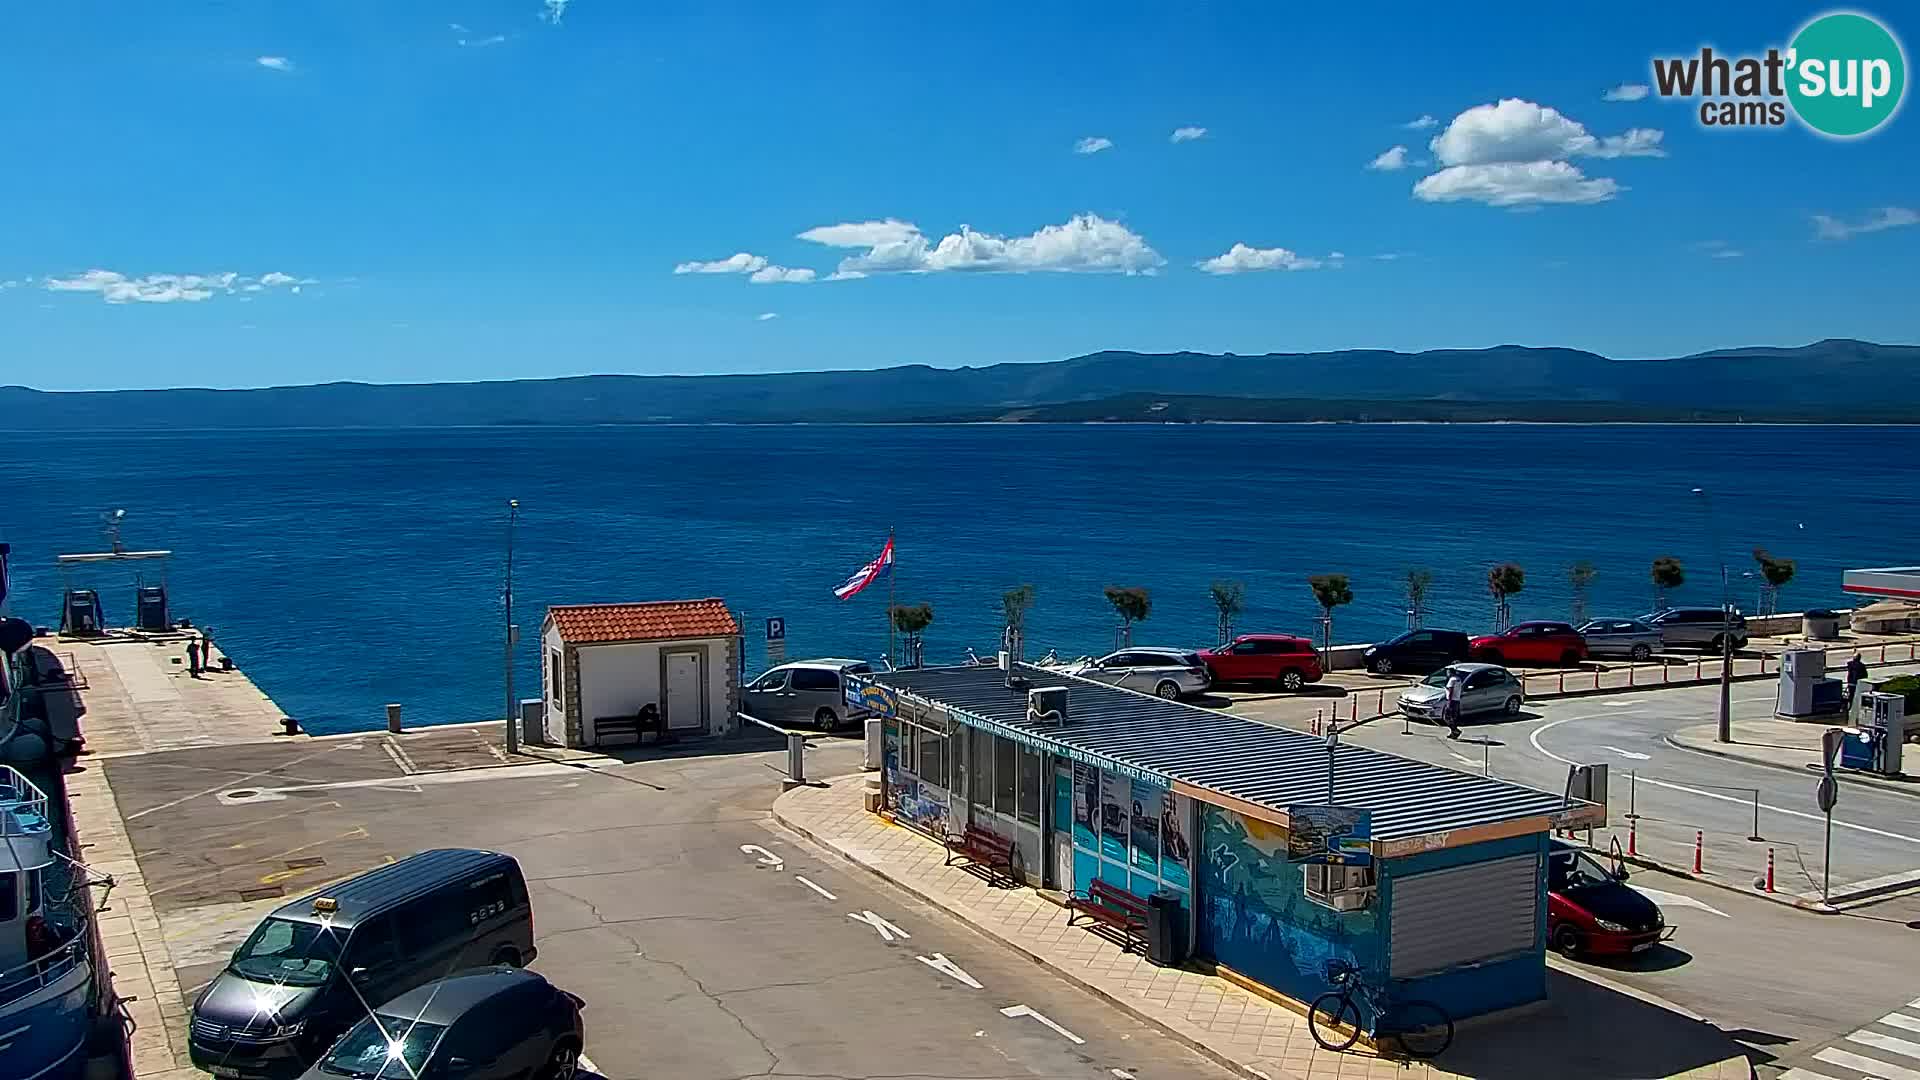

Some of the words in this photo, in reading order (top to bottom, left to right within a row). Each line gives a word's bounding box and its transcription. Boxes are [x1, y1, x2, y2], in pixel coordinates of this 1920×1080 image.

[770, 620, 781, 637] P
[994, 725, 1030, 744] AUTOBUSNA
[1030, 736, 1060, 753] POSTAJA
[1069, 750, 1082, 761] BUS
[1083, 753, 1114, 771] STATION
[1116, 763, 1140, 779] TICKET
[1141, 771, 1167, 787] OFFICE
